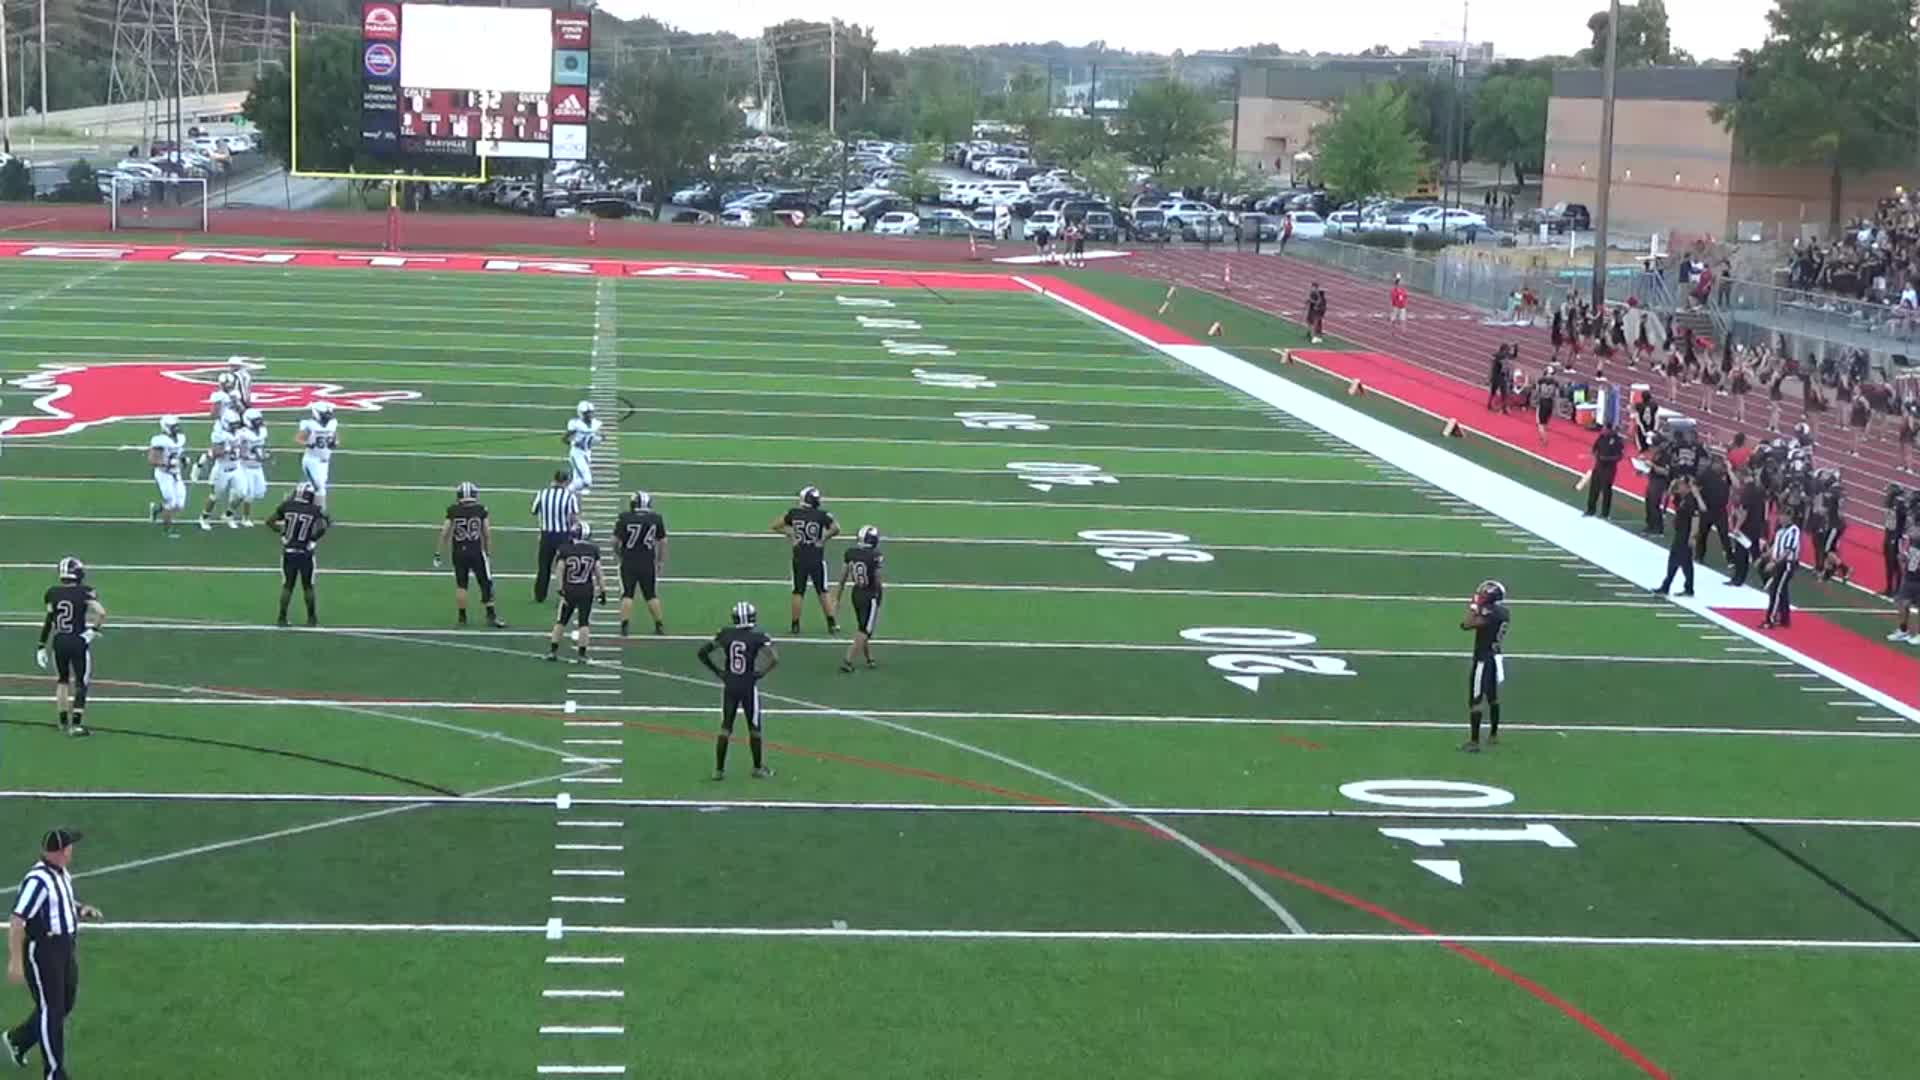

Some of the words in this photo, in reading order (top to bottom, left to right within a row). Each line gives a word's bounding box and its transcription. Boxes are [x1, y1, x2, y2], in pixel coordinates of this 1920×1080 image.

[284, 512, 315, 544] 77
[625, 523, 656, 550] 74
[1077, 528, 1215, 564] 30
[566, 556, 595, 585] 27
[729, 640, 748, 675] 6
[1178, 626, 1358, 678] 20
[1338, 778, 1578, 850] 10
